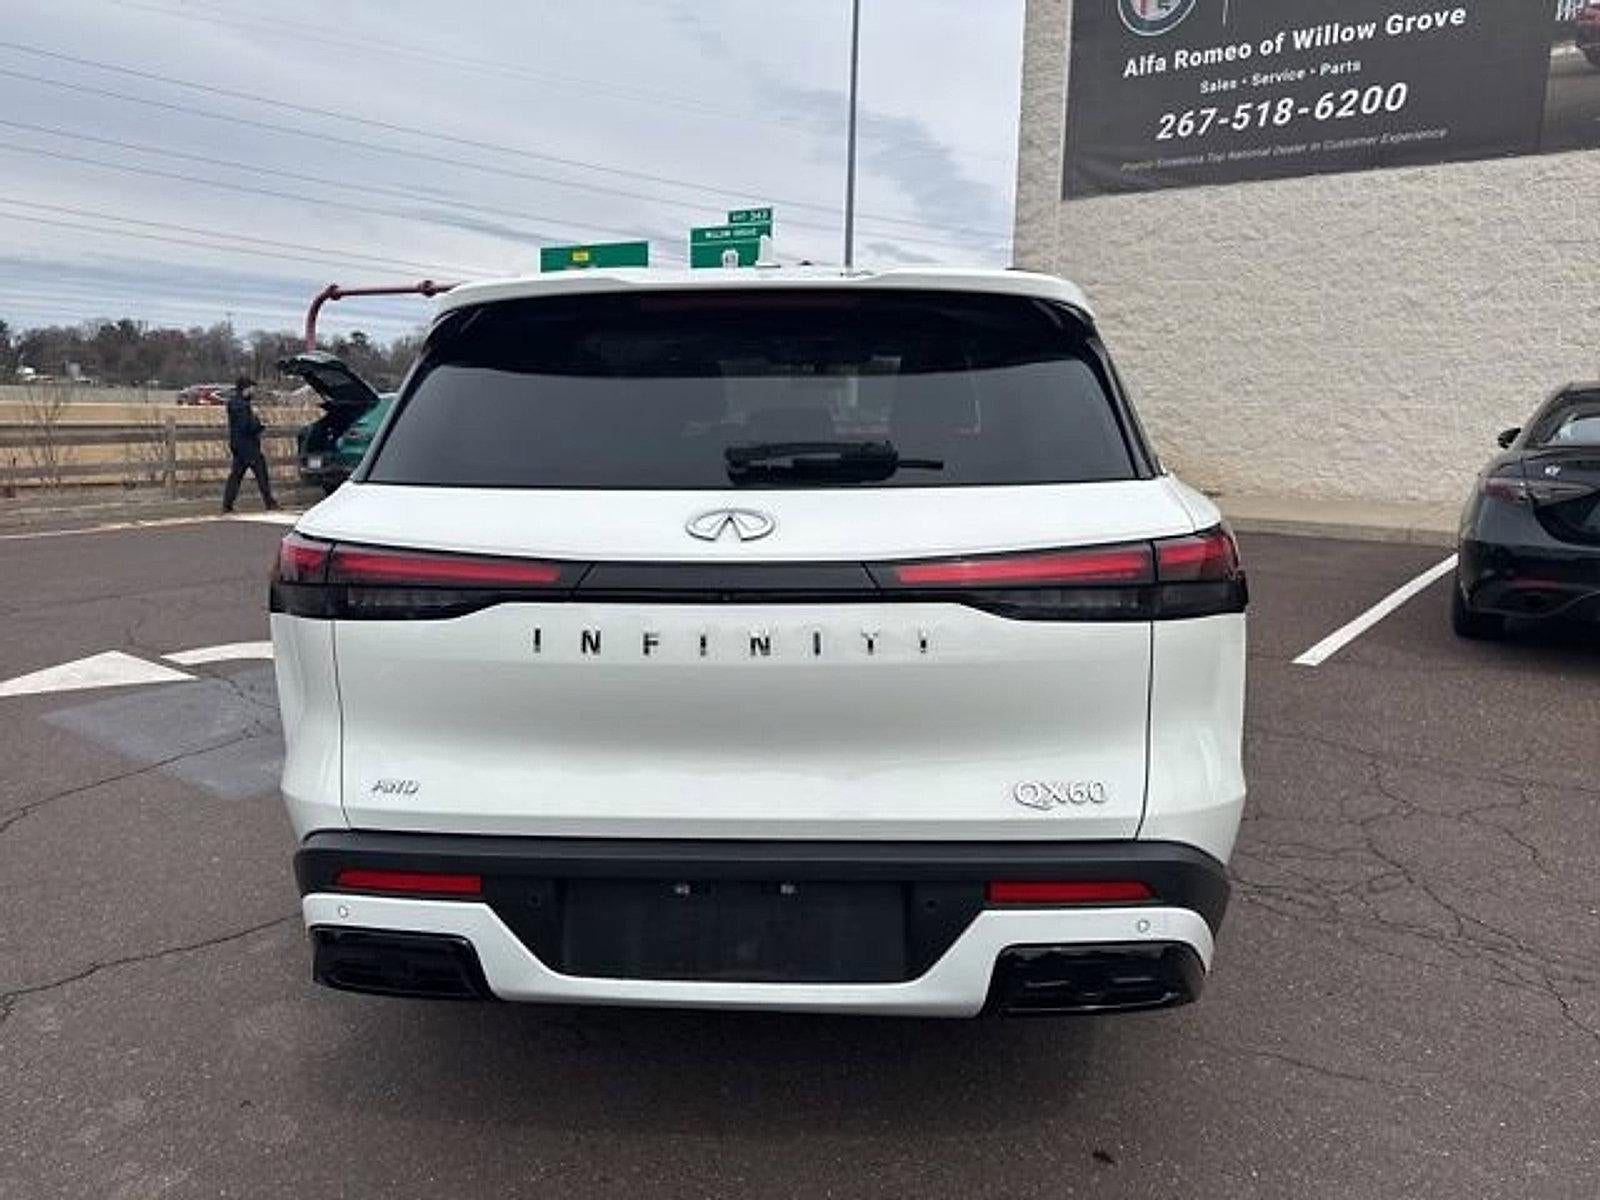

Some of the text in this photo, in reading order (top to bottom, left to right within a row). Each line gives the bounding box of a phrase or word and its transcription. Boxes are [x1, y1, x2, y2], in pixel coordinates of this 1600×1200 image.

[1122, 7, 1467, 78] Alfa Romeo of Willow Grove
[1200, 60, 1362, 94] Sales Service Parts
[1155, 81, 1409, 141] 267-518-6200
[533, 628, 928, 656] INFINITI
[1013, 781, 1107, 811] QX60
